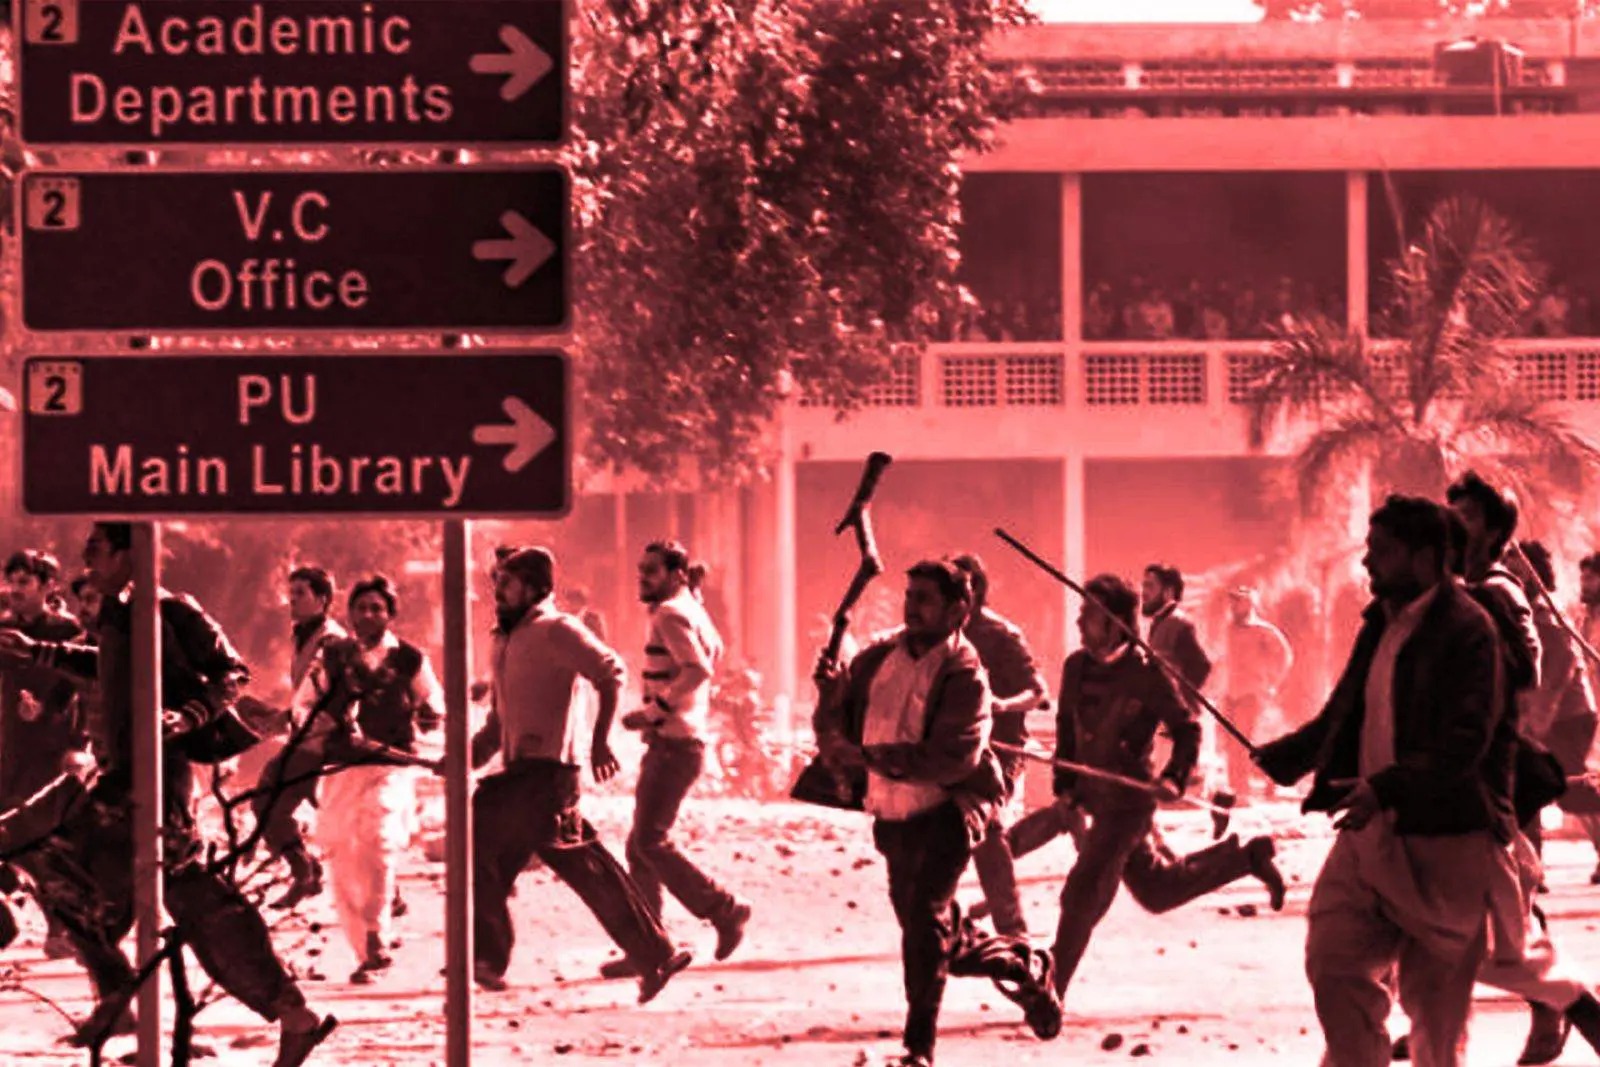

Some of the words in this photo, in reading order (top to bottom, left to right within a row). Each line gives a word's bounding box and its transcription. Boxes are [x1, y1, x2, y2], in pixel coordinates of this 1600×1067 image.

[40, 4, 64, 41] 2
[114, 4, 411, 54] Academic
[71, 73, 452, 135] Departments
[42, 190, 66, 227] 2
[234, 191, 328, 240] V.C
[191, 260, 368, 310] Office
[44, 376, 67, 411] 2
[239, 375, 316, 424] PU
[90, 445, 227, 494] Main
[253, 444, 471, 507] Library
